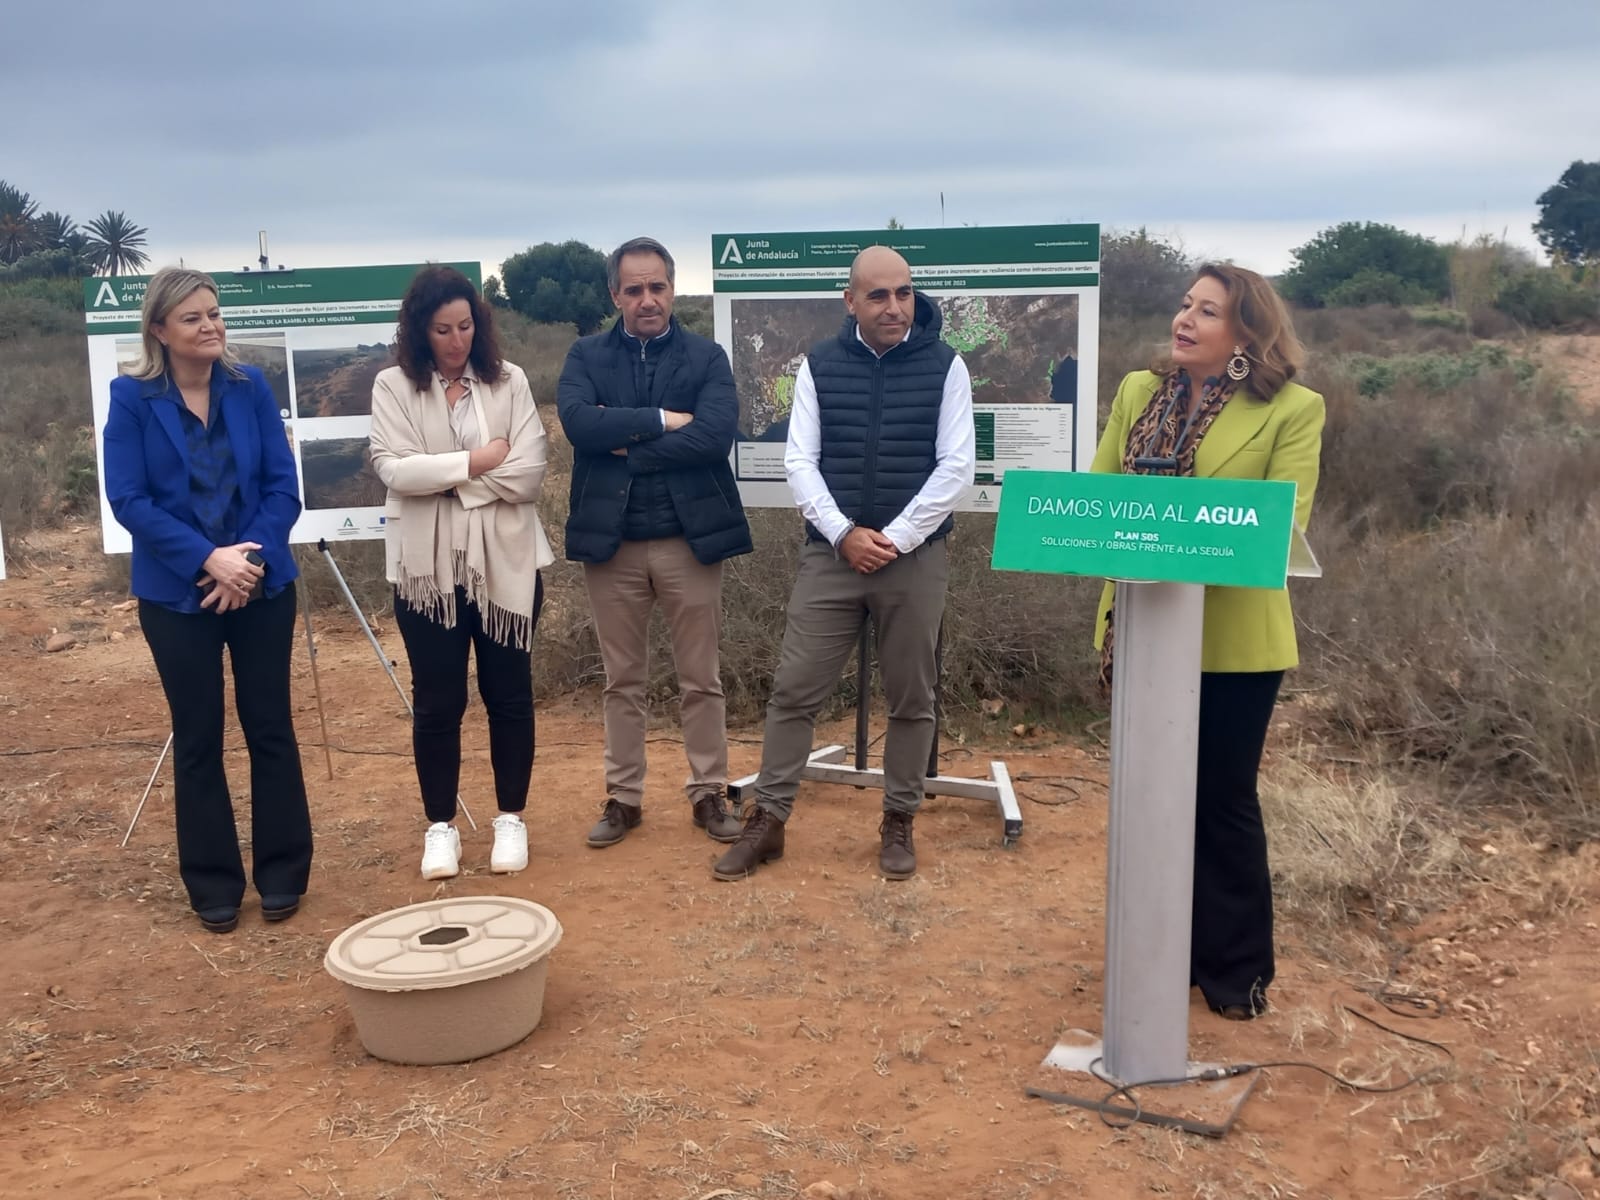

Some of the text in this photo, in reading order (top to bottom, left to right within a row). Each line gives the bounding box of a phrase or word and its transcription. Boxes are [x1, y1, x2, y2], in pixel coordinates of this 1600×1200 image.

[746, 240, 769, 249] Junta
[746, 249, 799, 260] de Andalucía
[121, 282, 147, 291] Junta
[121, 293, 134, 302] de
[1028, 496, 1259, 527] DAMOS VIDA AL AGUA
[1114, 530, 1160, 542] PLAN SOS
[1041, 536, 1235, 557] SOLUCIONES Y OBRAS FRENTE A LA SEQUÍA
